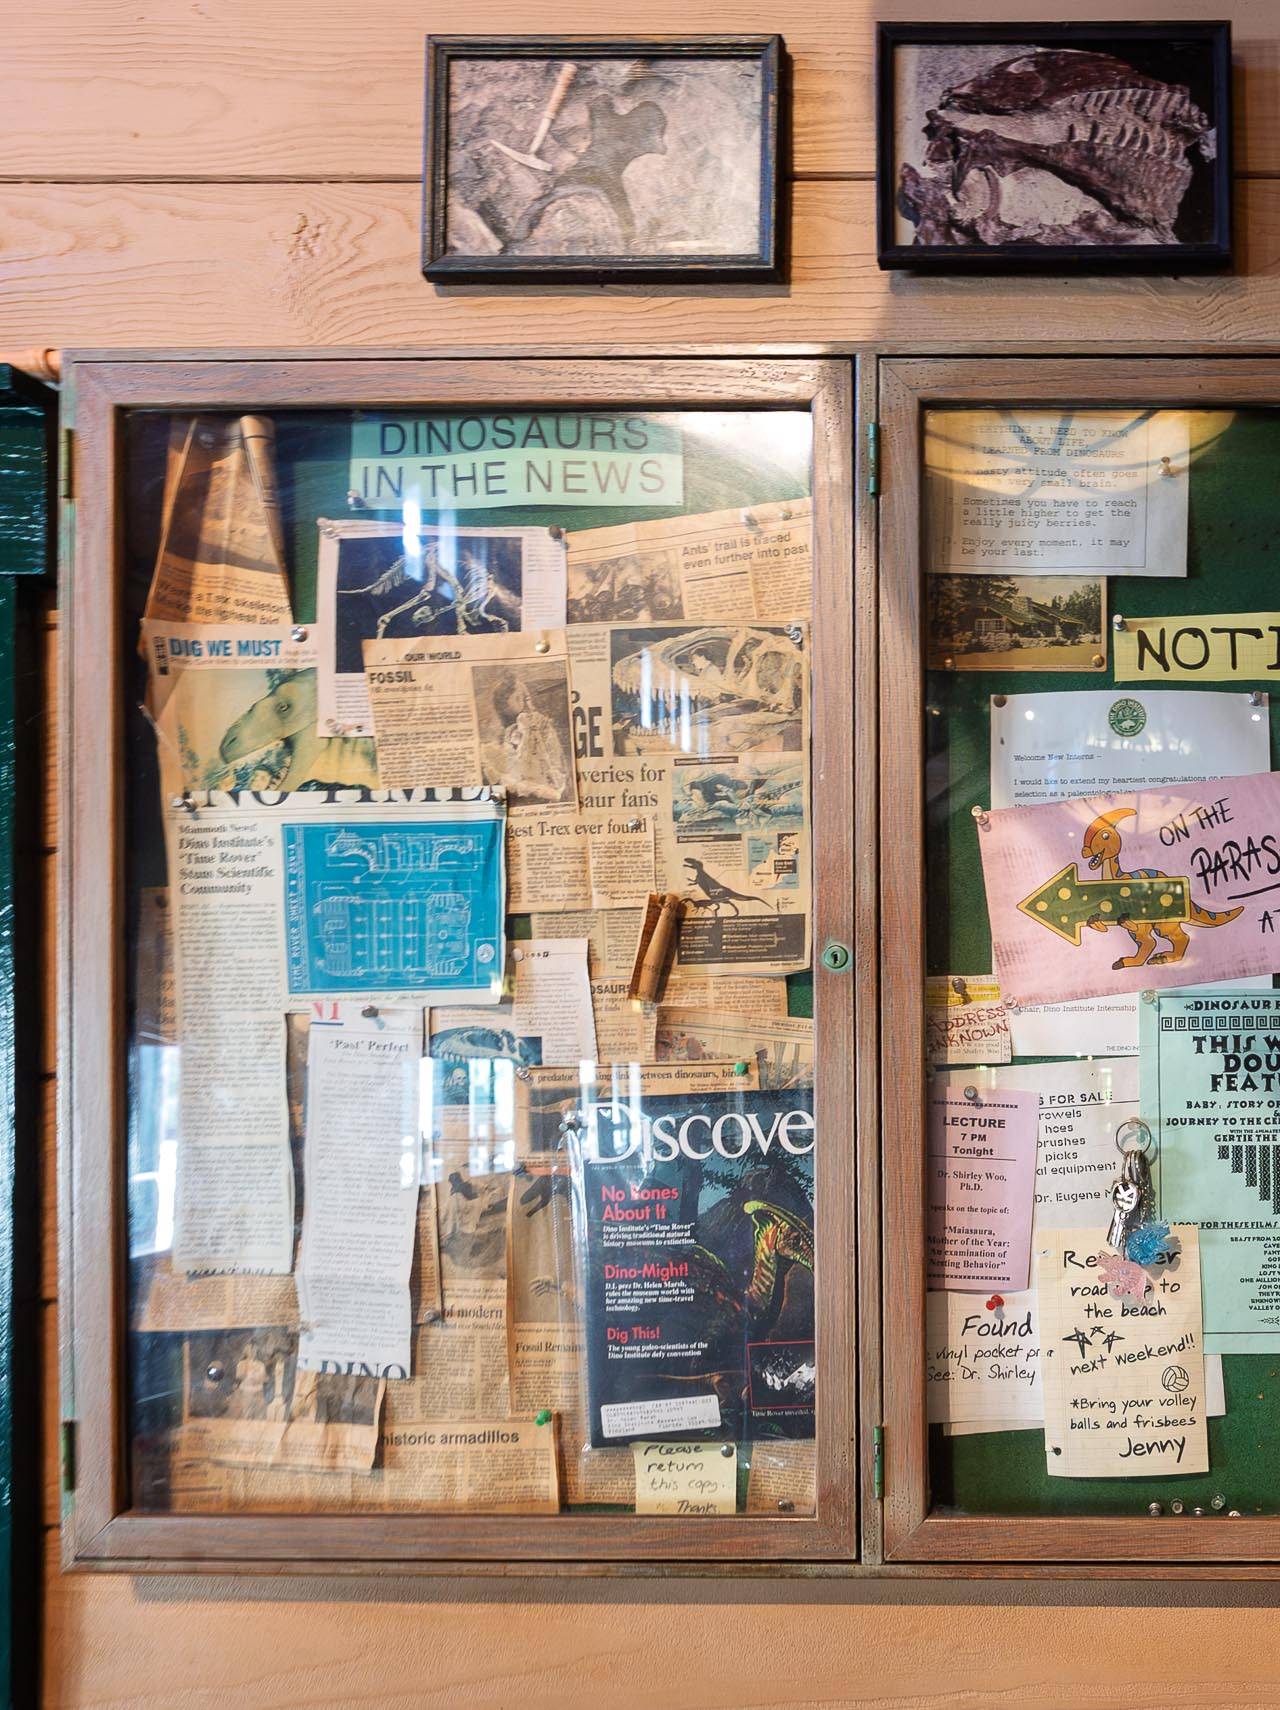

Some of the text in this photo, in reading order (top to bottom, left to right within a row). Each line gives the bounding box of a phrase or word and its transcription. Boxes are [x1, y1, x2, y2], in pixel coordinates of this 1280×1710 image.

[379, 415, 650, 457] DINOSAURS
[362, 459, 667, 498] IN THE NEWS
[714, 538, 736, 553] trail
[753, 531, 791, 548] traced
[683, 543, 810, 571] even further into past
[169, 638, 284, 658] DIG WE MUST
[369, 670, 417, 685] FOSSIL
[537, 821, 605, 838] T-rex ever
[1158, 796, 1235, 849] ON THE
[1018, 1004, 1137, 1014] Chair, Dino Institute Internship
[1193, 999, 1272, 1012] DINOSAUR
[1192, 1034, 1256, 1055] THIS
[1048, 1093, 1076, 1106] FOR
[1226, 1100, 1264, 1110] STORY
[943, 1116, 1007, 1129] LECTURE
[1045, 1123, 1075, 1135] hoes
[1165, 1117, 1219, 1127] JOURNEY
[1222, 1117, 1237, 1126] TO
[1240, 1117, 1262, 1126] THE
[960, 1133, 988, 1142] 7 PM
[1214, 1133, 1278, 1143] GERTIE THE
[952, 1145, 995, 1157] Tonight
[1045, 1150, 1079, 1163] picks
[936, 1170, 1008, 1182] Dr. Shirley Woo,
[1051, 1161, 1117, 1178] equipment
[601, 1185, 626, 1201] No
[959, 1182, 984, 1193] Ph.D.
[1034, 1190, 1101, 1204] Dr. Eugene
[602, 1203, 668, 1221] About It
[604, 1262, 689, 1281] Dino-Might!
[1070, 1282, 1109, 1297] road
[1158, 1278, 1181, 1294] to
[1084, 1300, 1167, 1319] the beach
[960, 1310, 1034, 1338] Found
[607, 1325, 660, 1344] Dig This!
[973, 1344, 1024, 1363] pocket
[1070, 1355, 1107, 1376] next
[1115, 1333, 1197, 1366] weekend!!
[961, 1364, 1036, 1386] Dr. Shirley
[1121, 1396, 1154, 1415] your
[1158, 1394, 1198, 1412] volley
[1070, 1415, 1197, 1430] balls and frisbees
[440, 1430, 520, 1446] armadillos
[643, 1443, 704, 1456] Please
[1118, 1435, 1187, 1463] Jenny
[647, 1461, 704, 1473] return
[650, 1478, 679, 1491] this
